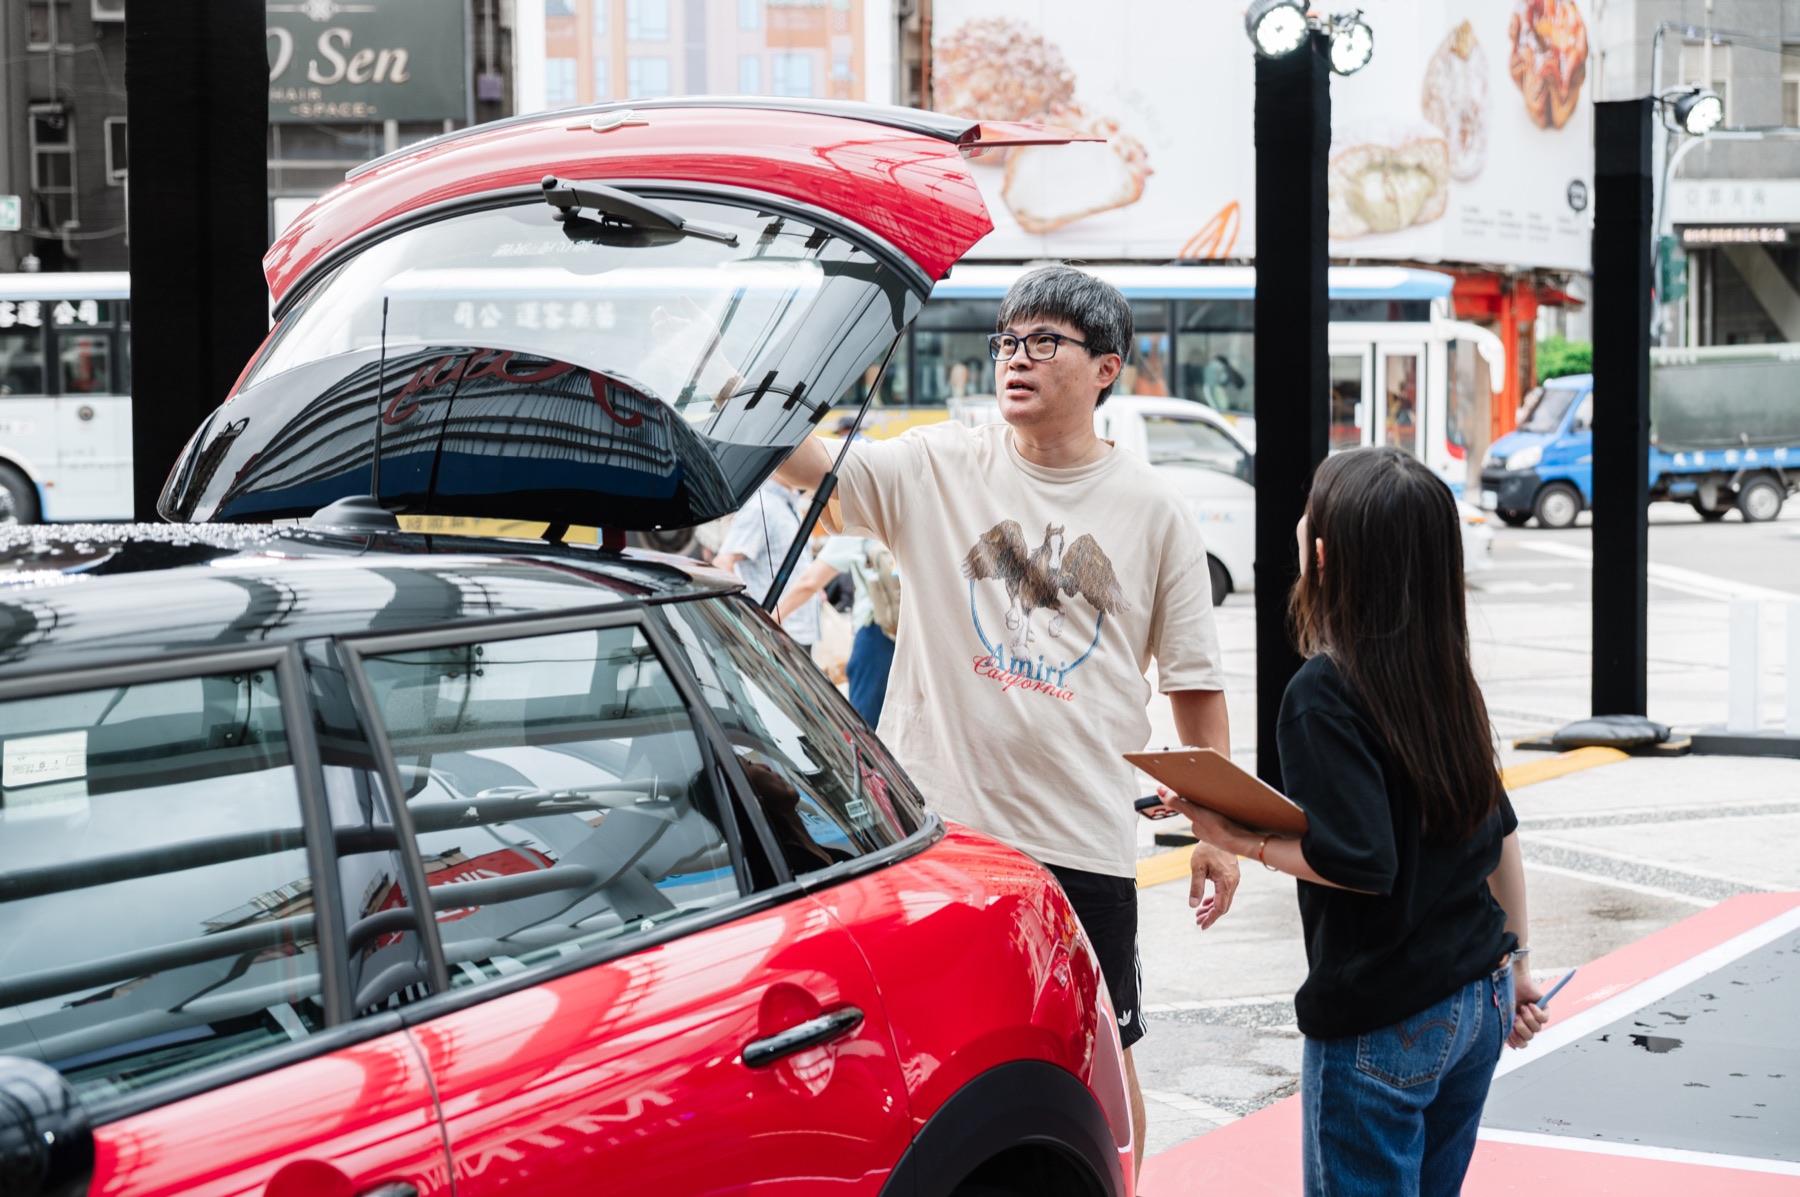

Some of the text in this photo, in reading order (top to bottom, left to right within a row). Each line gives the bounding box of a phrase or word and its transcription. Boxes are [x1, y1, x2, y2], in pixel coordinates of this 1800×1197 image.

[307, 27, 411, 85] Sen
[268, 87, 322, 103] HAIR
[972, 655, 1076, 702] California
[983, 643, 1066, 688] Amiri
